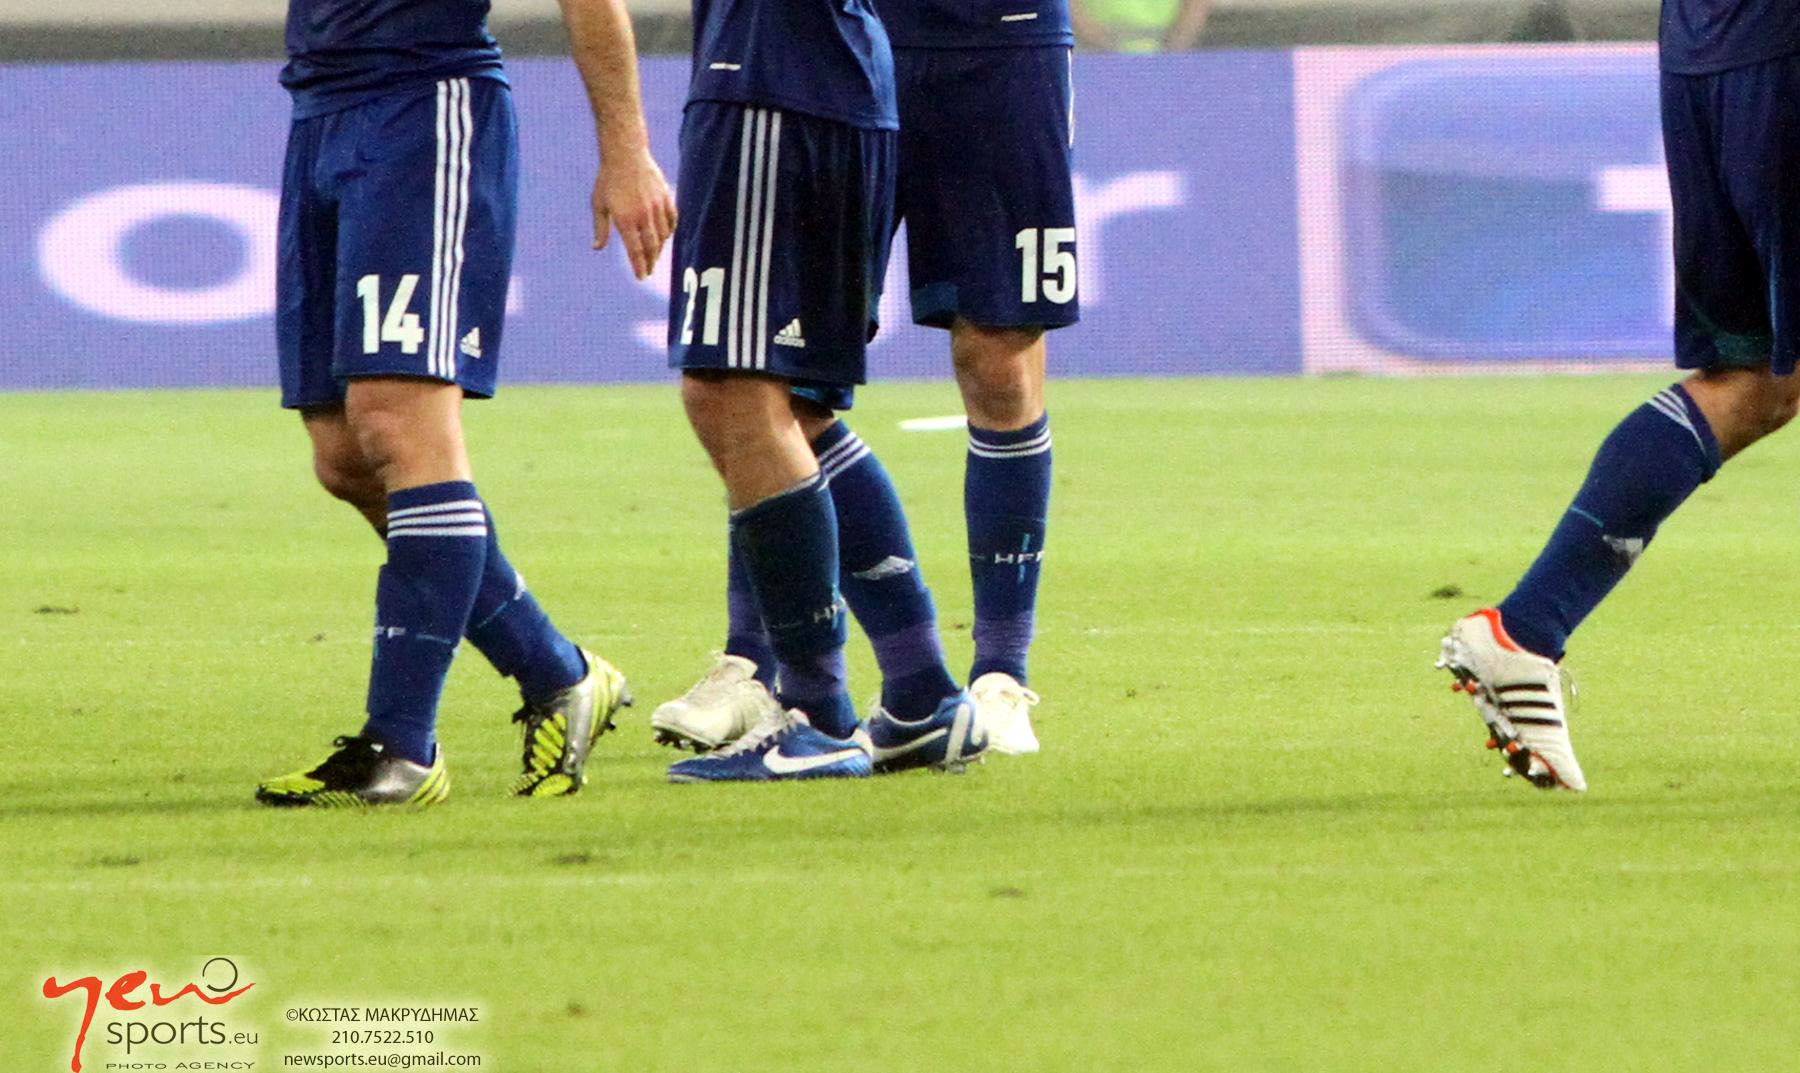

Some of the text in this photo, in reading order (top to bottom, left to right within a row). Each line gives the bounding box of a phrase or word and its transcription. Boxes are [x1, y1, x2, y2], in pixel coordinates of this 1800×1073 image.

[1015, 227, 1077, 304] 15
[356, 274, 425, 355] 14
[681, 266, 725, 346] 21
